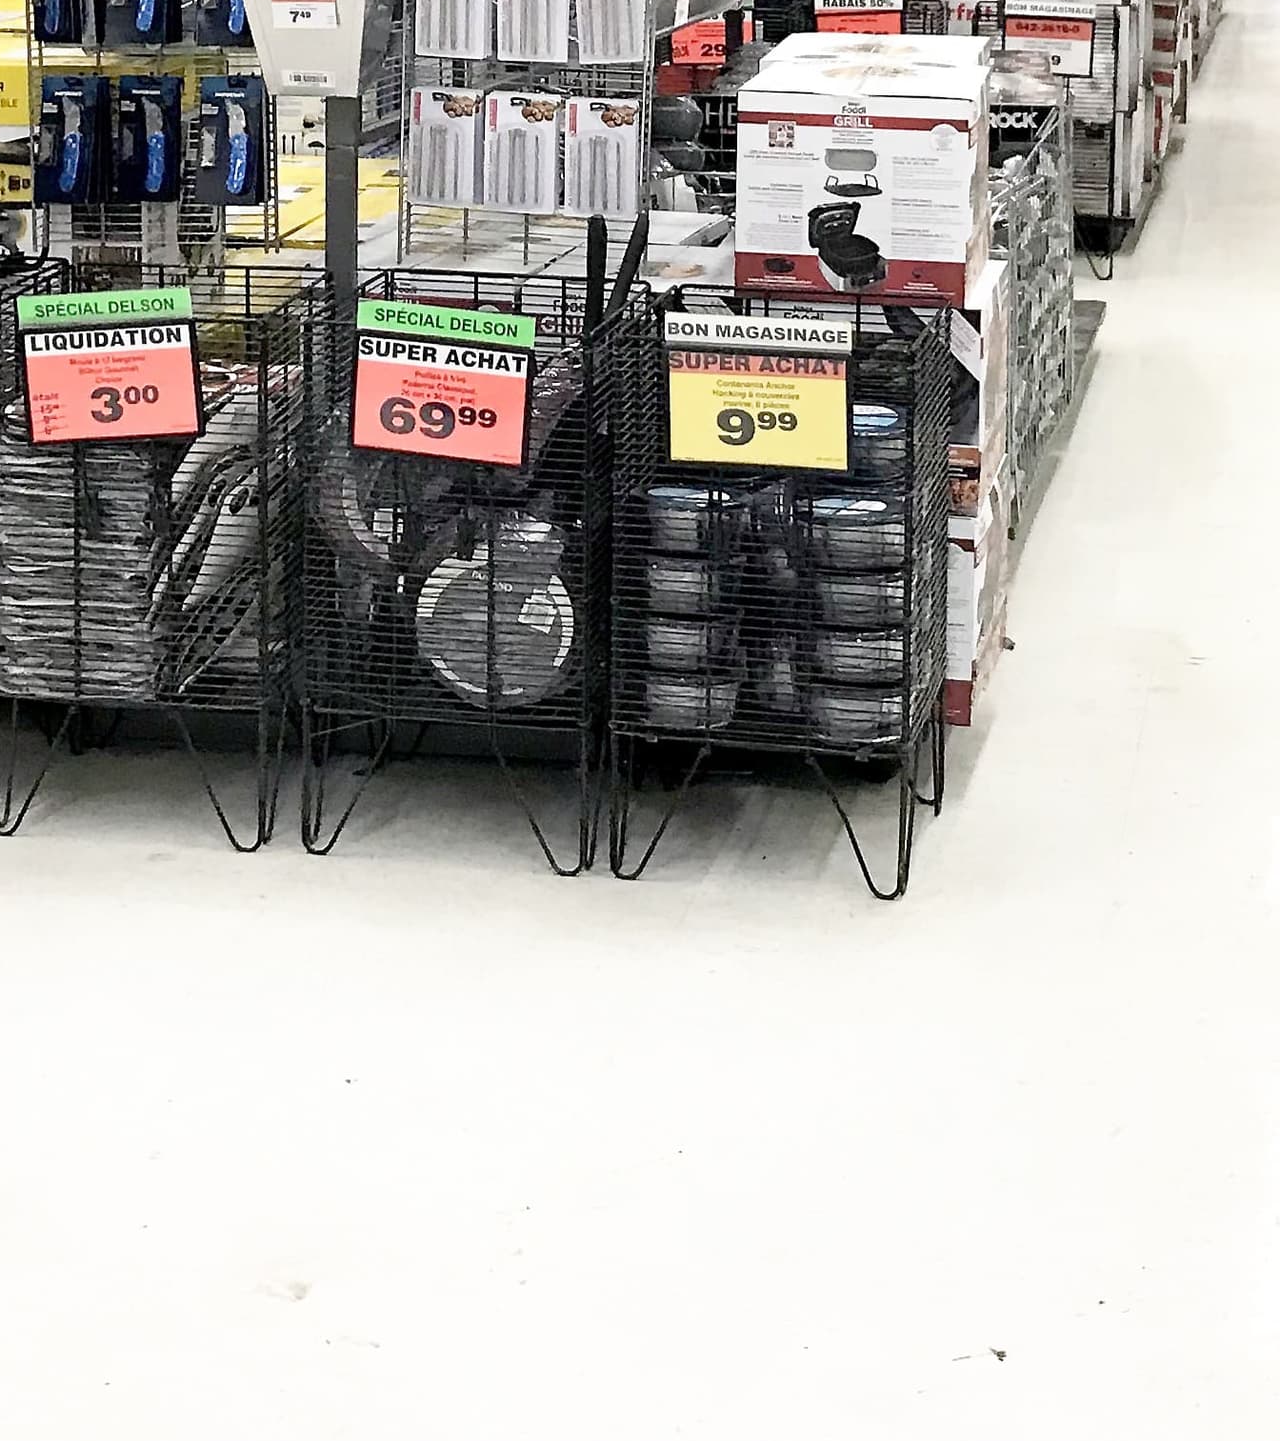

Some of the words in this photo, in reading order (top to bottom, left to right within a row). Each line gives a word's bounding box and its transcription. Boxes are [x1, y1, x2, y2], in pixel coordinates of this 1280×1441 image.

[833, 116, 874, 129] GRILL
[34, 300, 105, 318] SPÉCIAL
[108, 297, 175, 314] DELSON
[374, 306, 445, 329] SPÉCIAL
[449, 316, 519, 338] DELSON
[668, 322, 709, 337] BON
[715, 324, 848, 344] MAGASINAGE
[30, 327, 182, 352] LIQUIDATION
[359, 338, 438, 362] SUPER
[445, 348, 527, 373] ACHAT
[670, 351, 751, 372] SUPER
[758, 356, 844, 375] ACHAT
